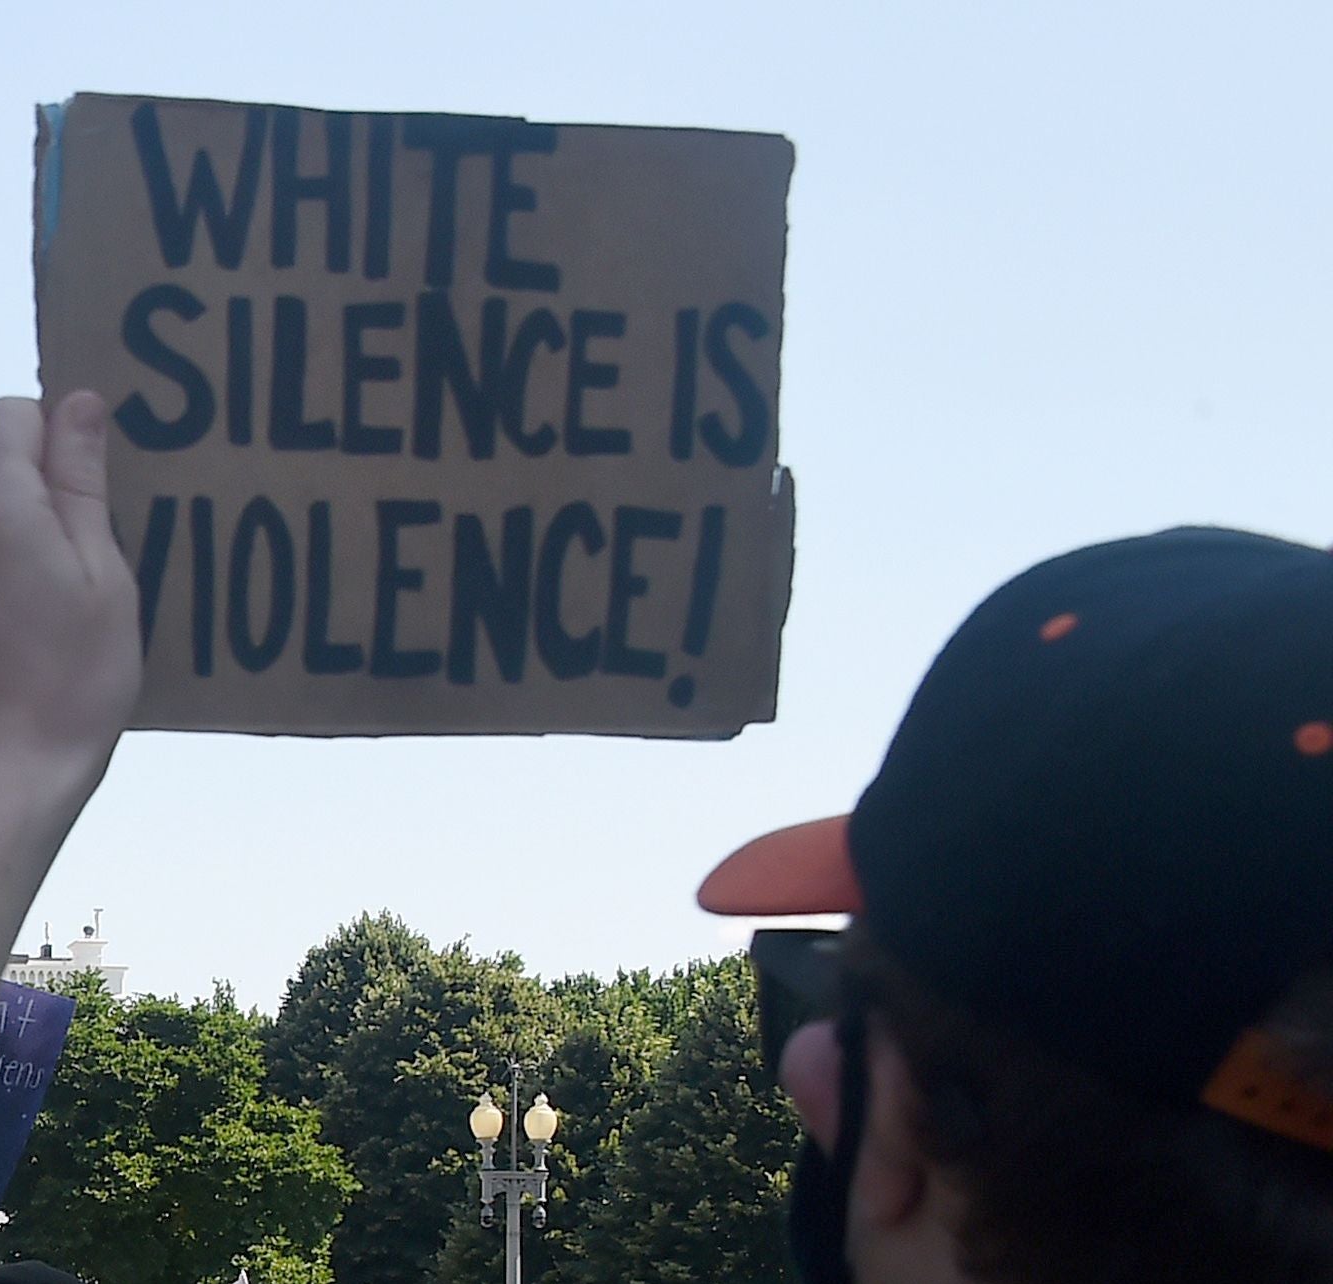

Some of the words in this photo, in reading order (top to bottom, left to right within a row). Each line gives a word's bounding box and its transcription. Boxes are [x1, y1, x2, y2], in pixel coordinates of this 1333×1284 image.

[130, 100, 562, 292] WHITE
[114, 284, 632, 460] SILENCE
[669, 302, 771, 467] IS
